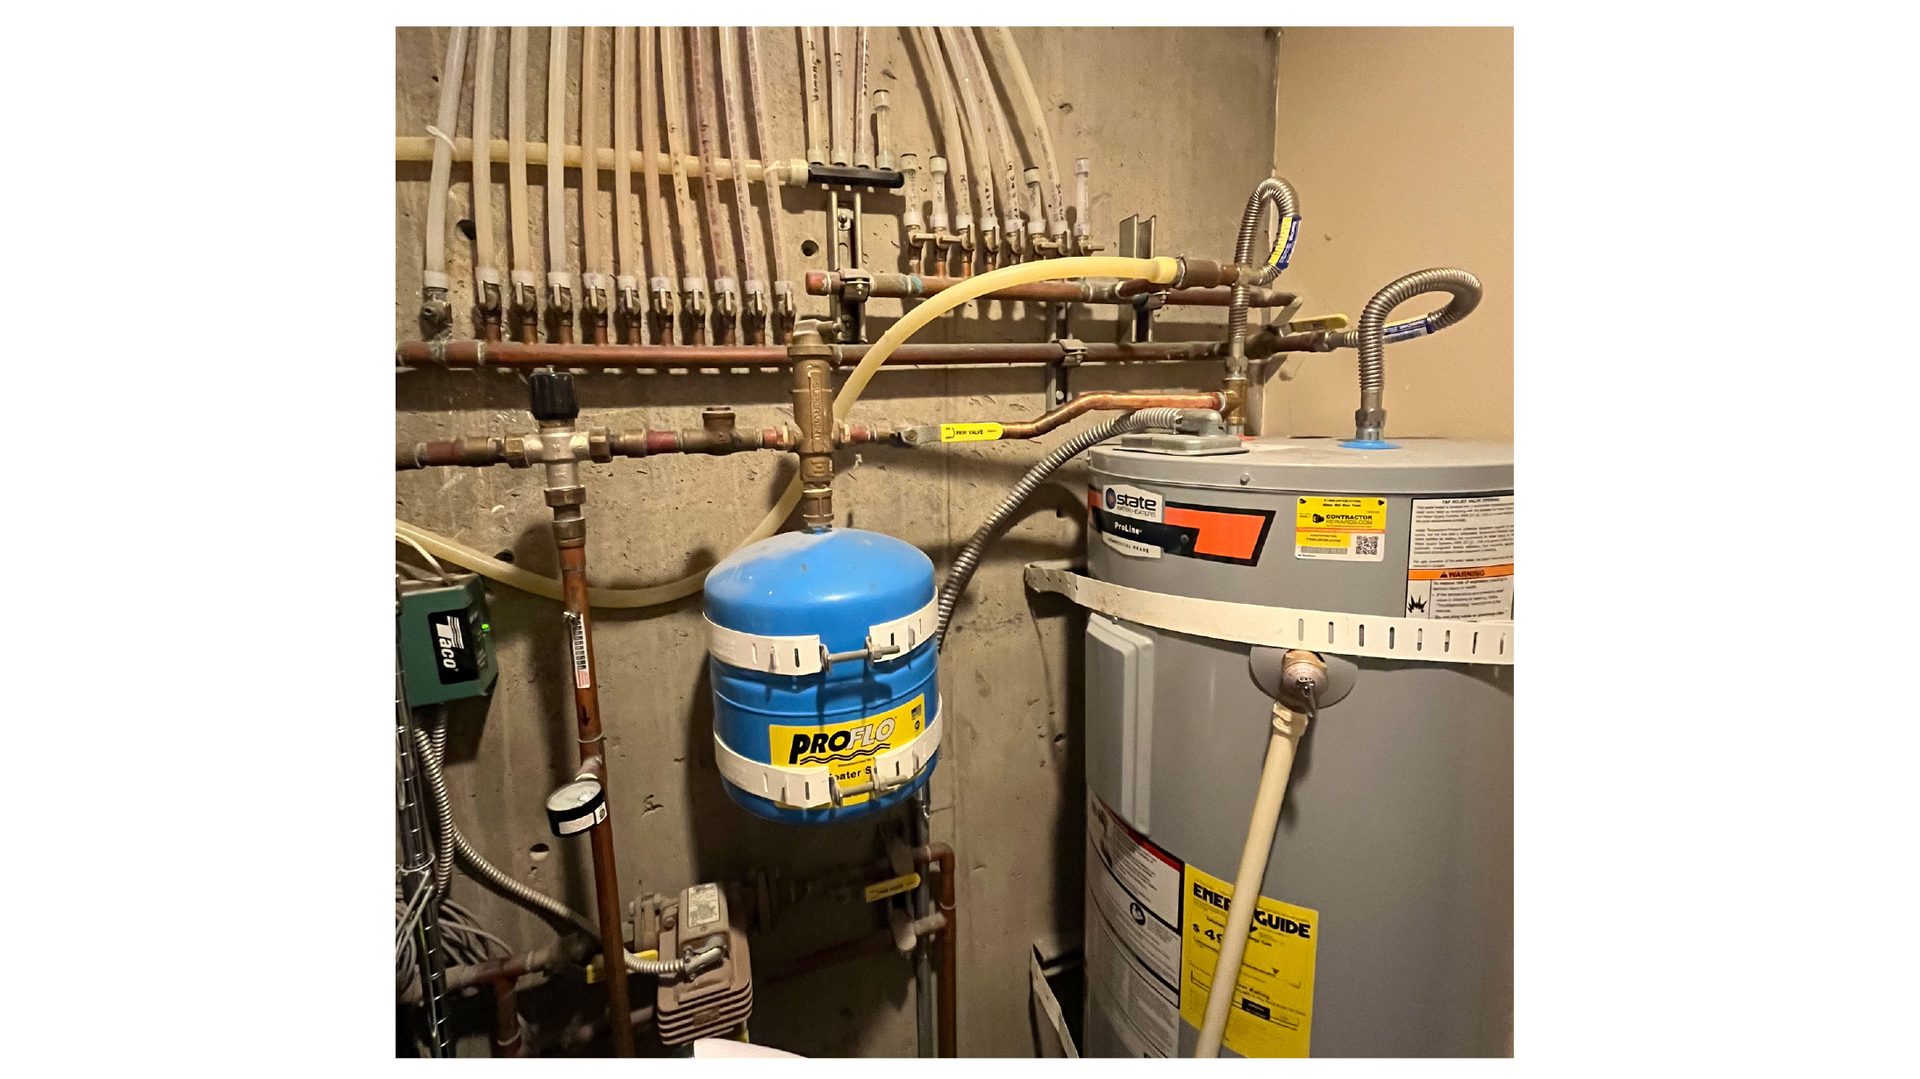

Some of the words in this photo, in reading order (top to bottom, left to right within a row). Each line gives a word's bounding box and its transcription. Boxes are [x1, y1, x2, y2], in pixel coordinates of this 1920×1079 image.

[1117, 494, 1156, 511] state
[1448, 569, 1485, 578] WARNING
[435, 615, 465, 669] Taco
[788, 717, 896, 765] PROFLO
